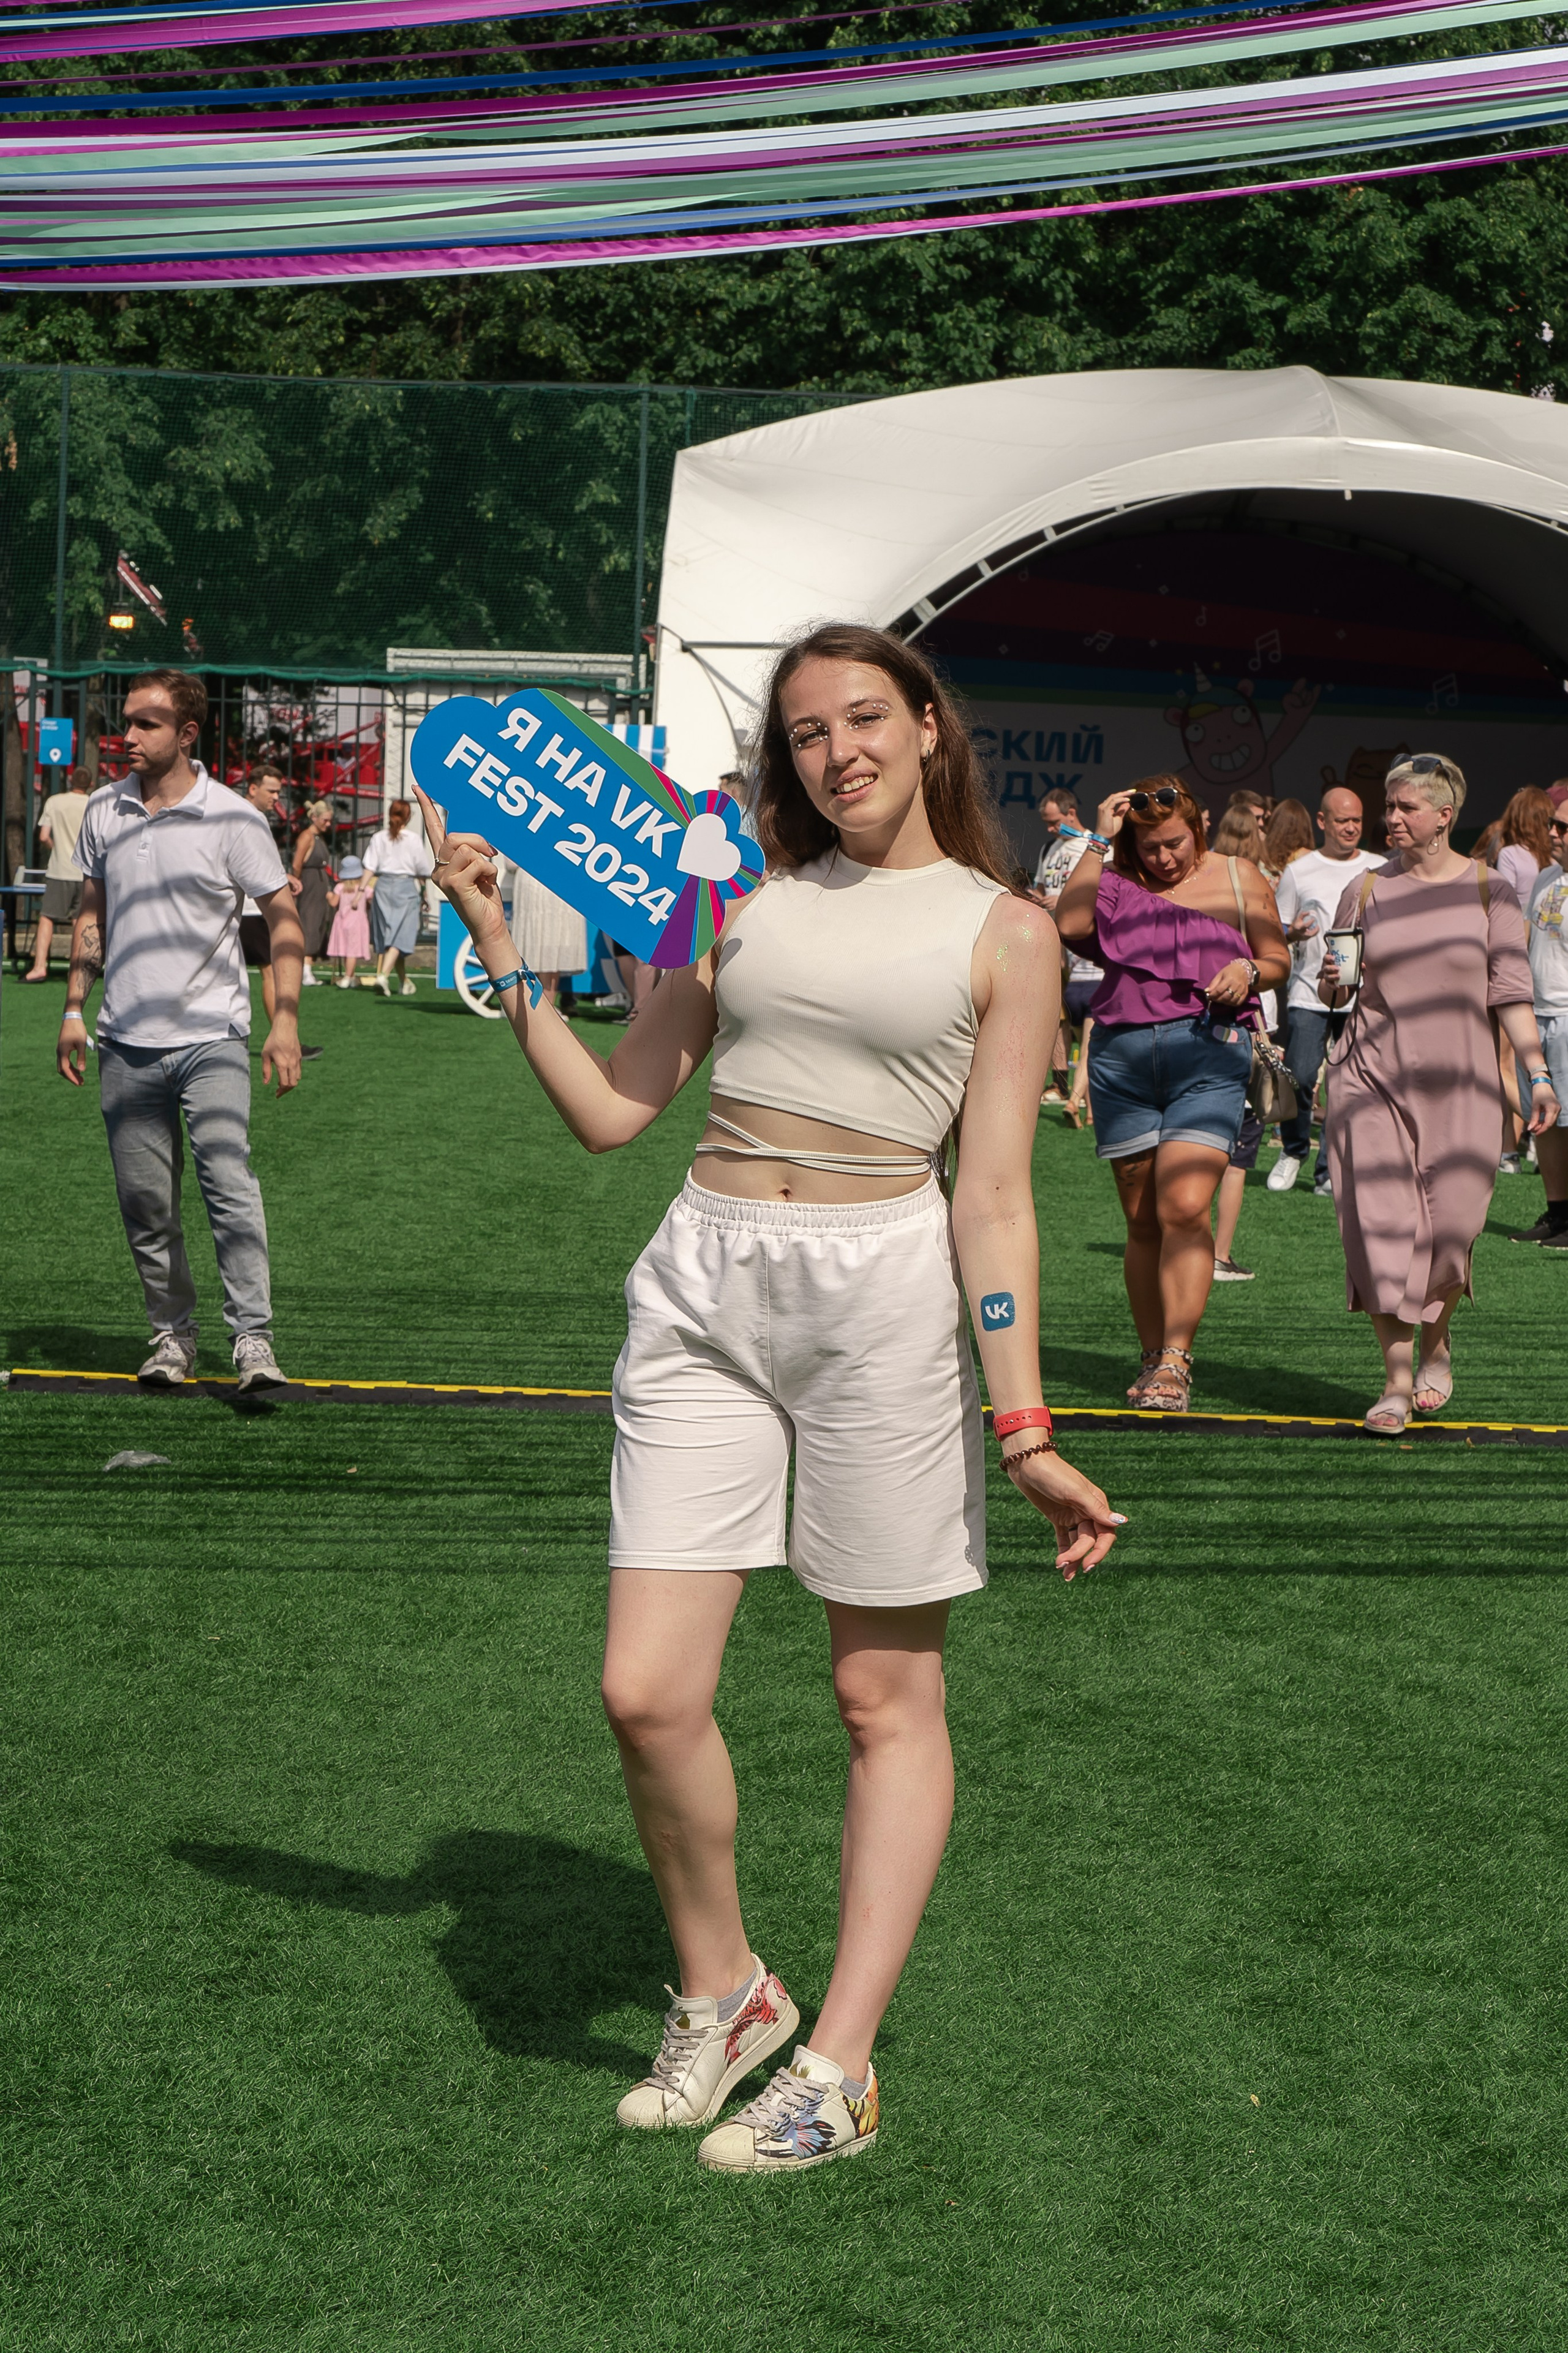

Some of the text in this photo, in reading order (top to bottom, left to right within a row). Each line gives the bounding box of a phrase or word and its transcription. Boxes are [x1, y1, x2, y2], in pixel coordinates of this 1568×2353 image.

[971, 724, 1104, 765] СКИЙ
[497, 706, 682, 858] Я НА VK
[986, 771, 1083, 809] ДЖ
[443, 733, 677, 926] FEST 2024
[985, 1302, 1009, 1320] VK
